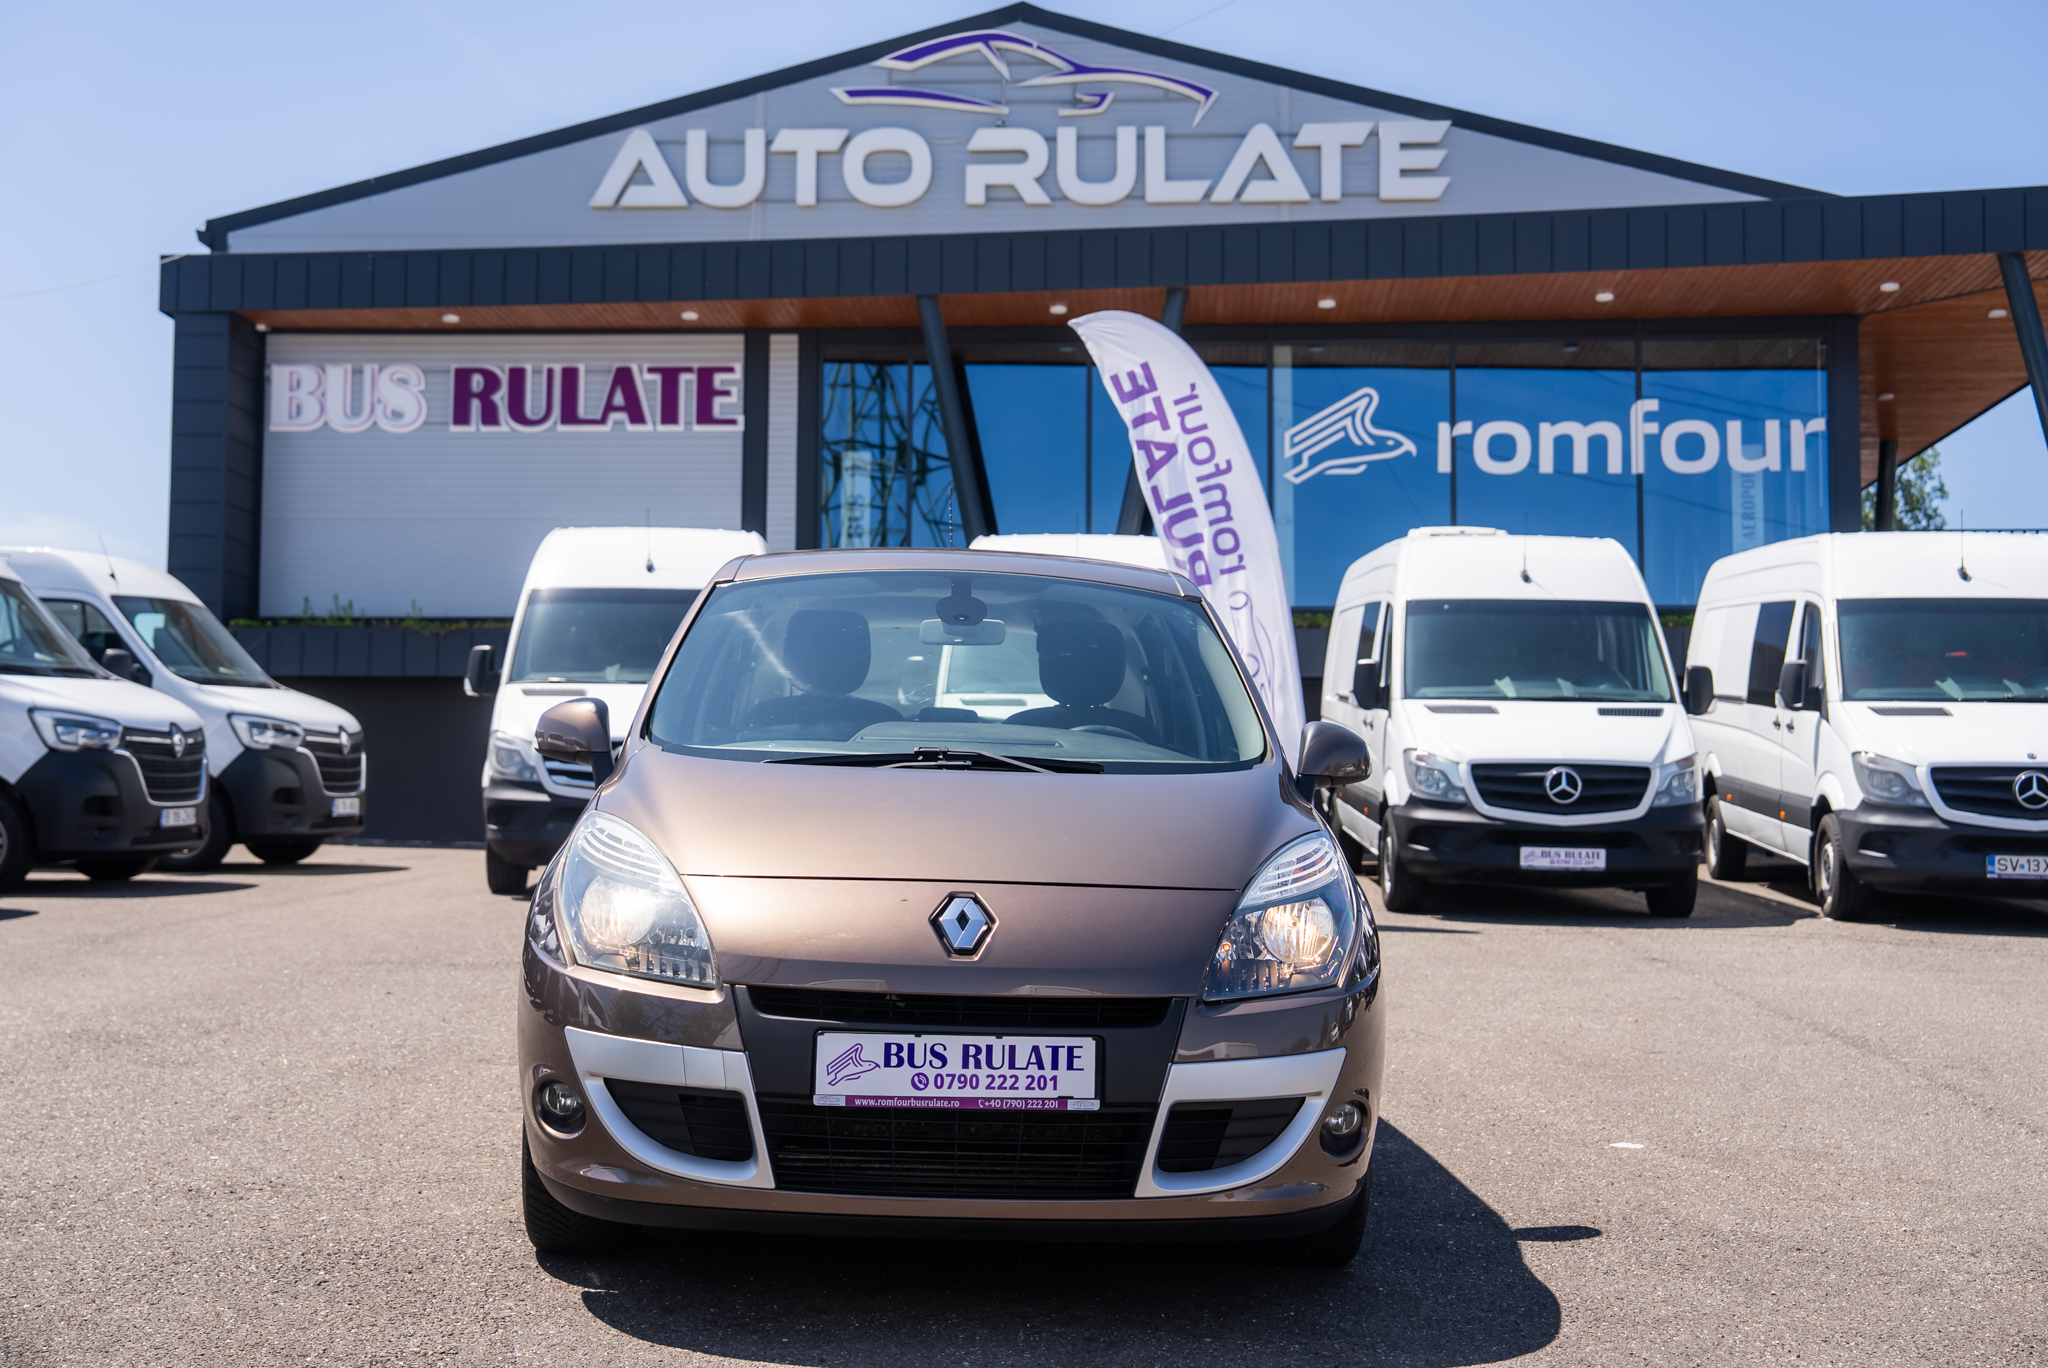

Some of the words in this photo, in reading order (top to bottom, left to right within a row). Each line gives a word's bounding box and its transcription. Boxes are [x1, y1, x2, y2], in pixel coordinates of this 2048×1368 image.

[589, 127, 933, 209] AUTO
[965, 119, 1453, 206] RULATE
[267, 362, 429, 434] BUS
[449, 362, 746, 433] RULATE
[1436, 398, 1826, 474] romfour
[1997, 857, 2020, 872] SV
[883, 1042, 948, 1070] BUS
[961, 1043, 1085, 1072] RULATE
[934, 1073, 980, 1090] 0790
[985, 1074, 1019, 1091] 222
[1025, 1075, 1058, 1091] 201
[854, 1097, 960, 1108] www.romfourbusrulate.ro
[984, 1099, 1000, 1108] +40
[1003, 1099, 1025, 1109] (790)
[1027, 1100, 1042, 1108] 222
[1044, 1100, 1058, 1109] 201
